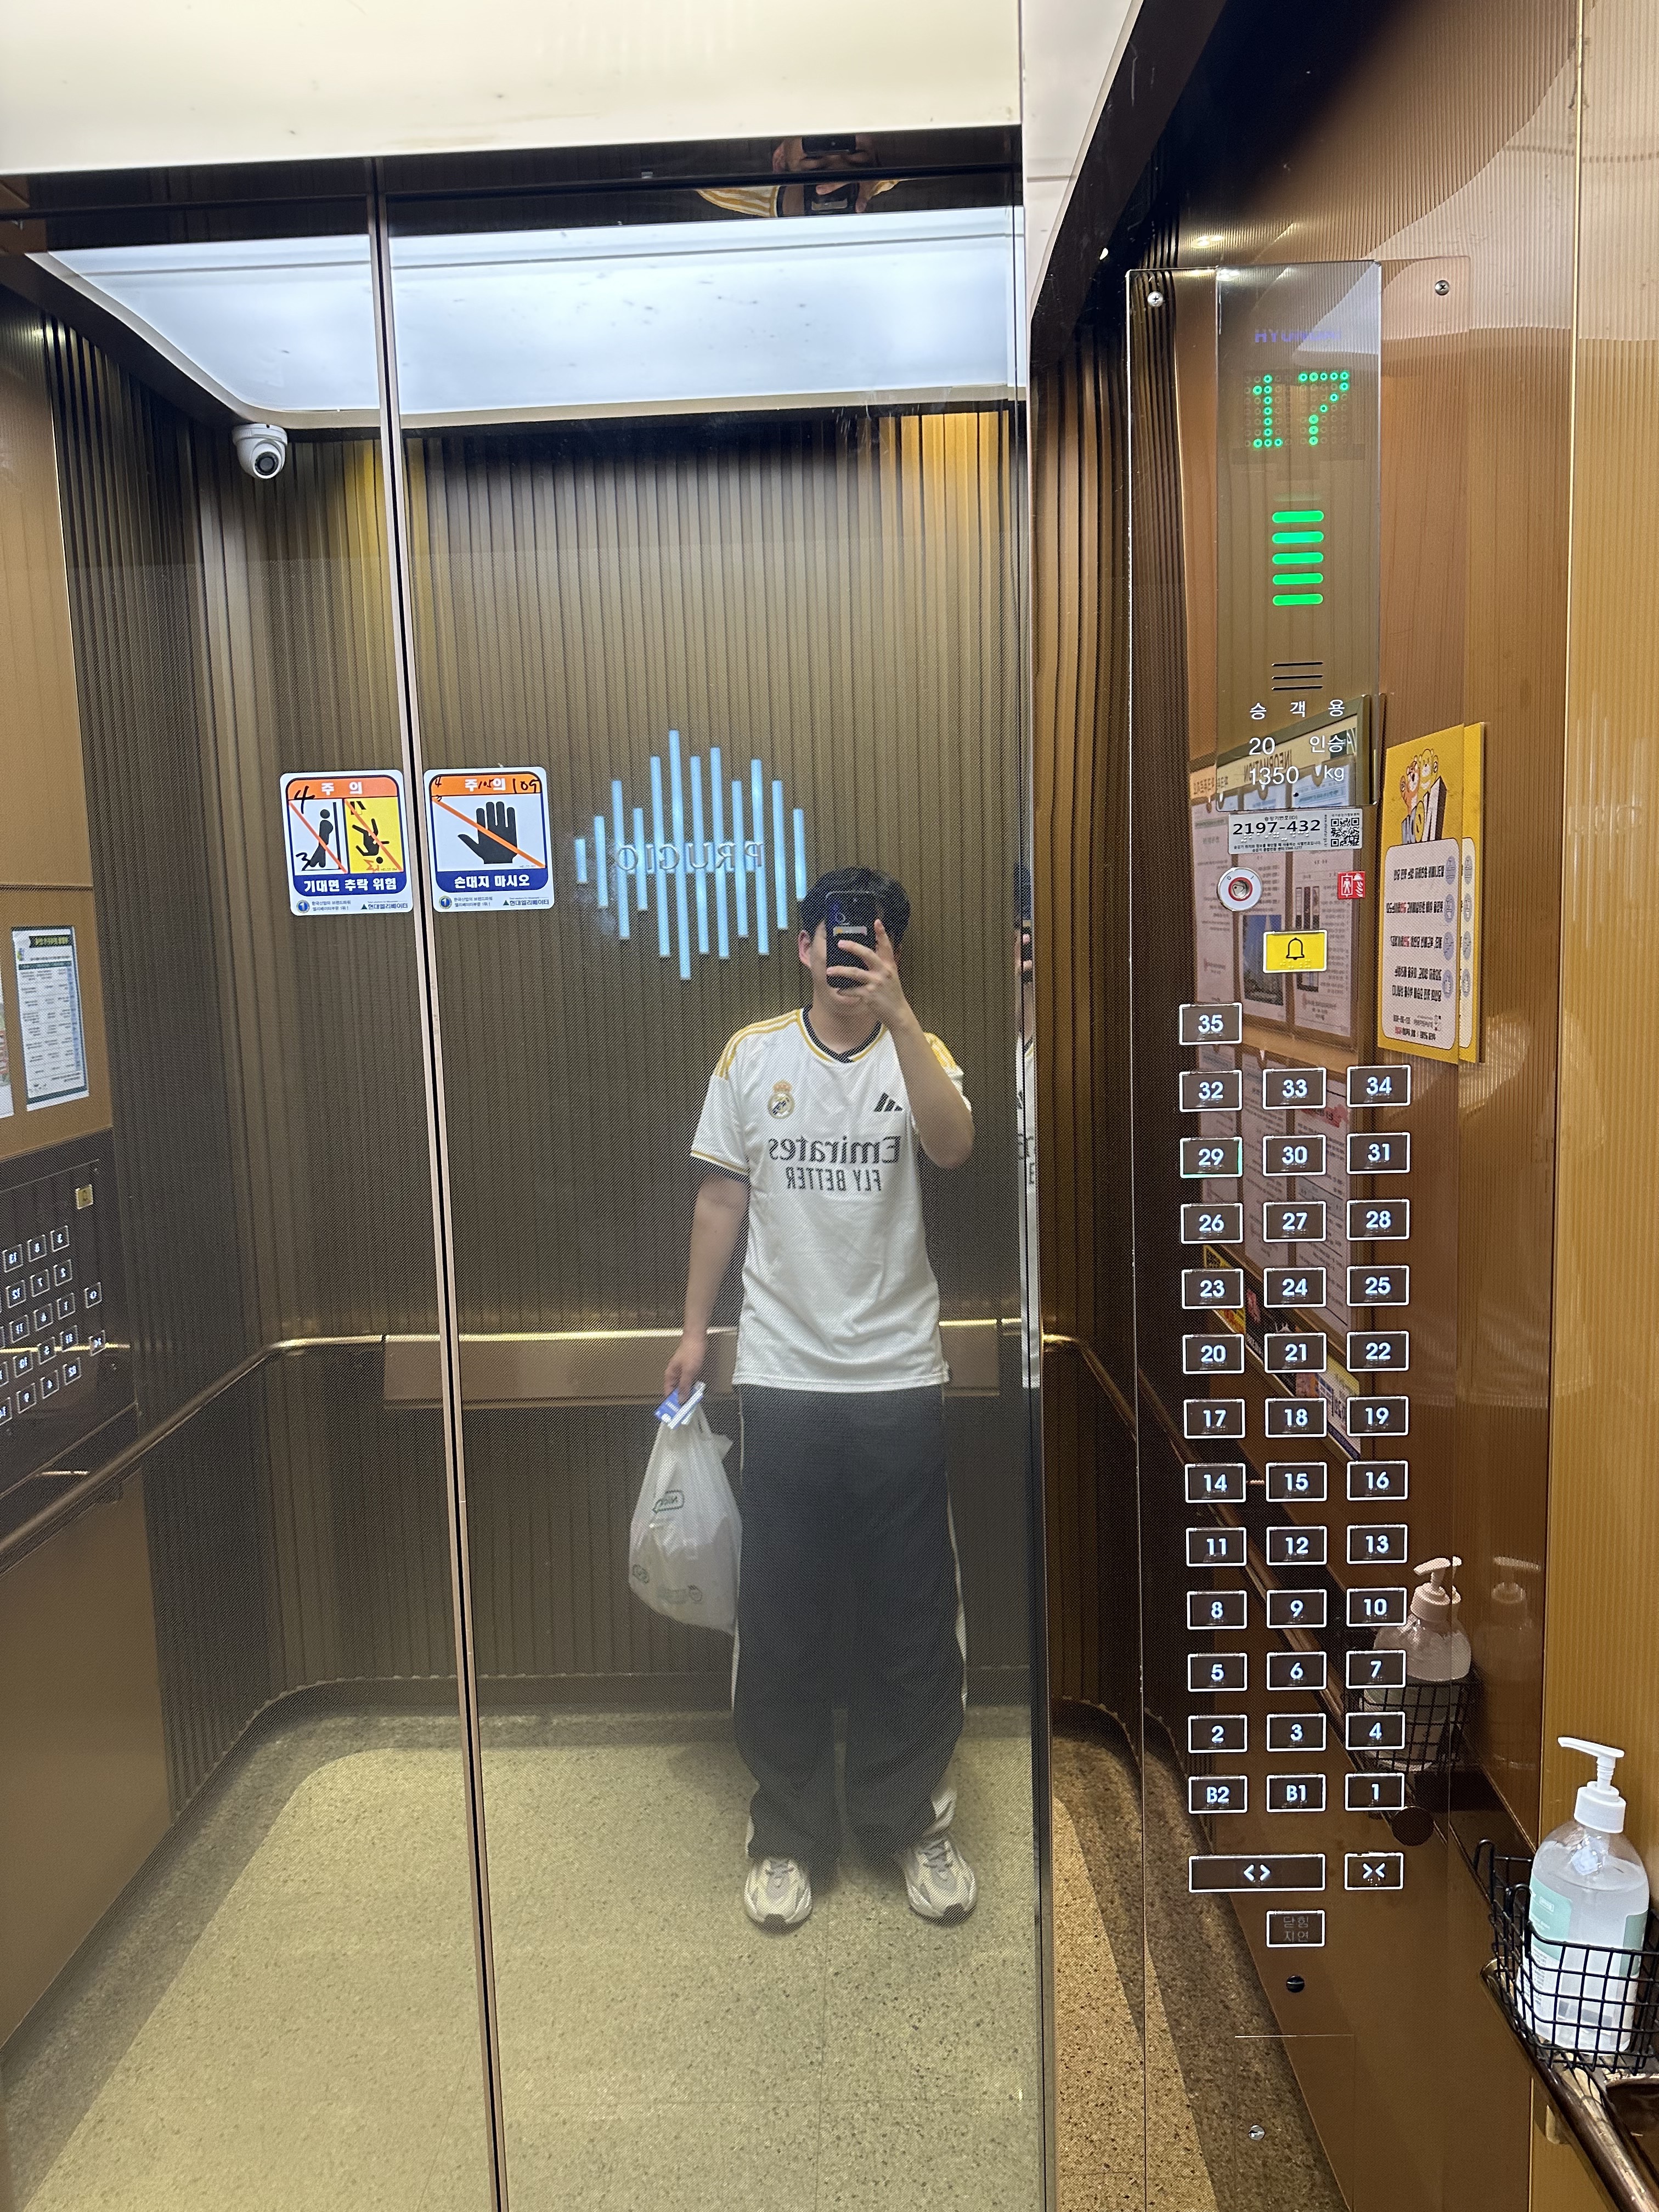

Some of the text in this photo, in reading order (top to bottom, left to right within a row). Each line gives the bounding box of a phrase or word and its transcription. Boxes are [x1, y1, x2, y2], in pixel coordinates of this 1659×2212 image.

[1251, 371, 1350, 448] 17
[1249, 735, 1345, 755] 20 인승
[1250, 765, 1344, 785] 1350 kg
[1233, 819, 1321, 835] 2197-432
[303, 877, 397, 893] 기대면 추락 위험
[454, 874, 530, 889] 손대지 마시오
[1198, 1014, 1223, 1034] 35
[1198, 1081, 1223, 1099] 32
[1282, 1079, 1307, 1099] 33
[1366, 1076, 1392, 1096] 34
[1198, 1148, 1224, 1166] 29
[1282, 1146, 1307, 1166] 30
[1368, 1143, 1390, 1163] 31
[1199, 1214, 1224, 1232] 26
[1282, 1212, 1307, 1230] 27
[1365, 1210, 1391, 1228] 28
[1200, 1279, 1225, 1299] 23
[1282, 1278, 1308, 1297] 24
[1365, 1277, 1391, 1294] 25
[1200, 1345, 1226, 1363] 20
[1285, 1344, 1307, 1361] 21
[1365, 1342, 1391, 1360] 22
[1203, 1409, 1226, 1429] 17
[1284, 1408, 1308, 1427] 18
[1365, 1407, 1389, 1425] 19
[1203, 1474, 1227, 1493] 14
[1284, 1473, 1308, 1492] 15
[1365, 1471, 1389, 1491] 16
[1206, 1538, 1226, 1555] 11
[1285, 1537, 1308, 1556] 12
[1365, 1535, 1389, 1554] 13
[1211, 1601, 1223, 1620] 8
[1290, 1600, 1304, 1618] 9
[1363, 1598, 1387, 1617] 10
[1211, 1664, 1224, 1682] 5
[1290, 1662, 1303, 1680] 6
[1370, 1661, 1381, 1679] 7
[1211, 1725, 1224, 1743] 2
[1290, 1724, 1302, 1742] 3
[1369, 1722, 1382, 1741] 4
[1206, 1786, 1229, 1804] B2
[1286, 1785, 1306, 1801] B1
[1372, 1784, 1379, 1800] 1
[1283, 1916, 1308, 1928] 닫힘
[1283, 1931, 1308, 1943] 지연
